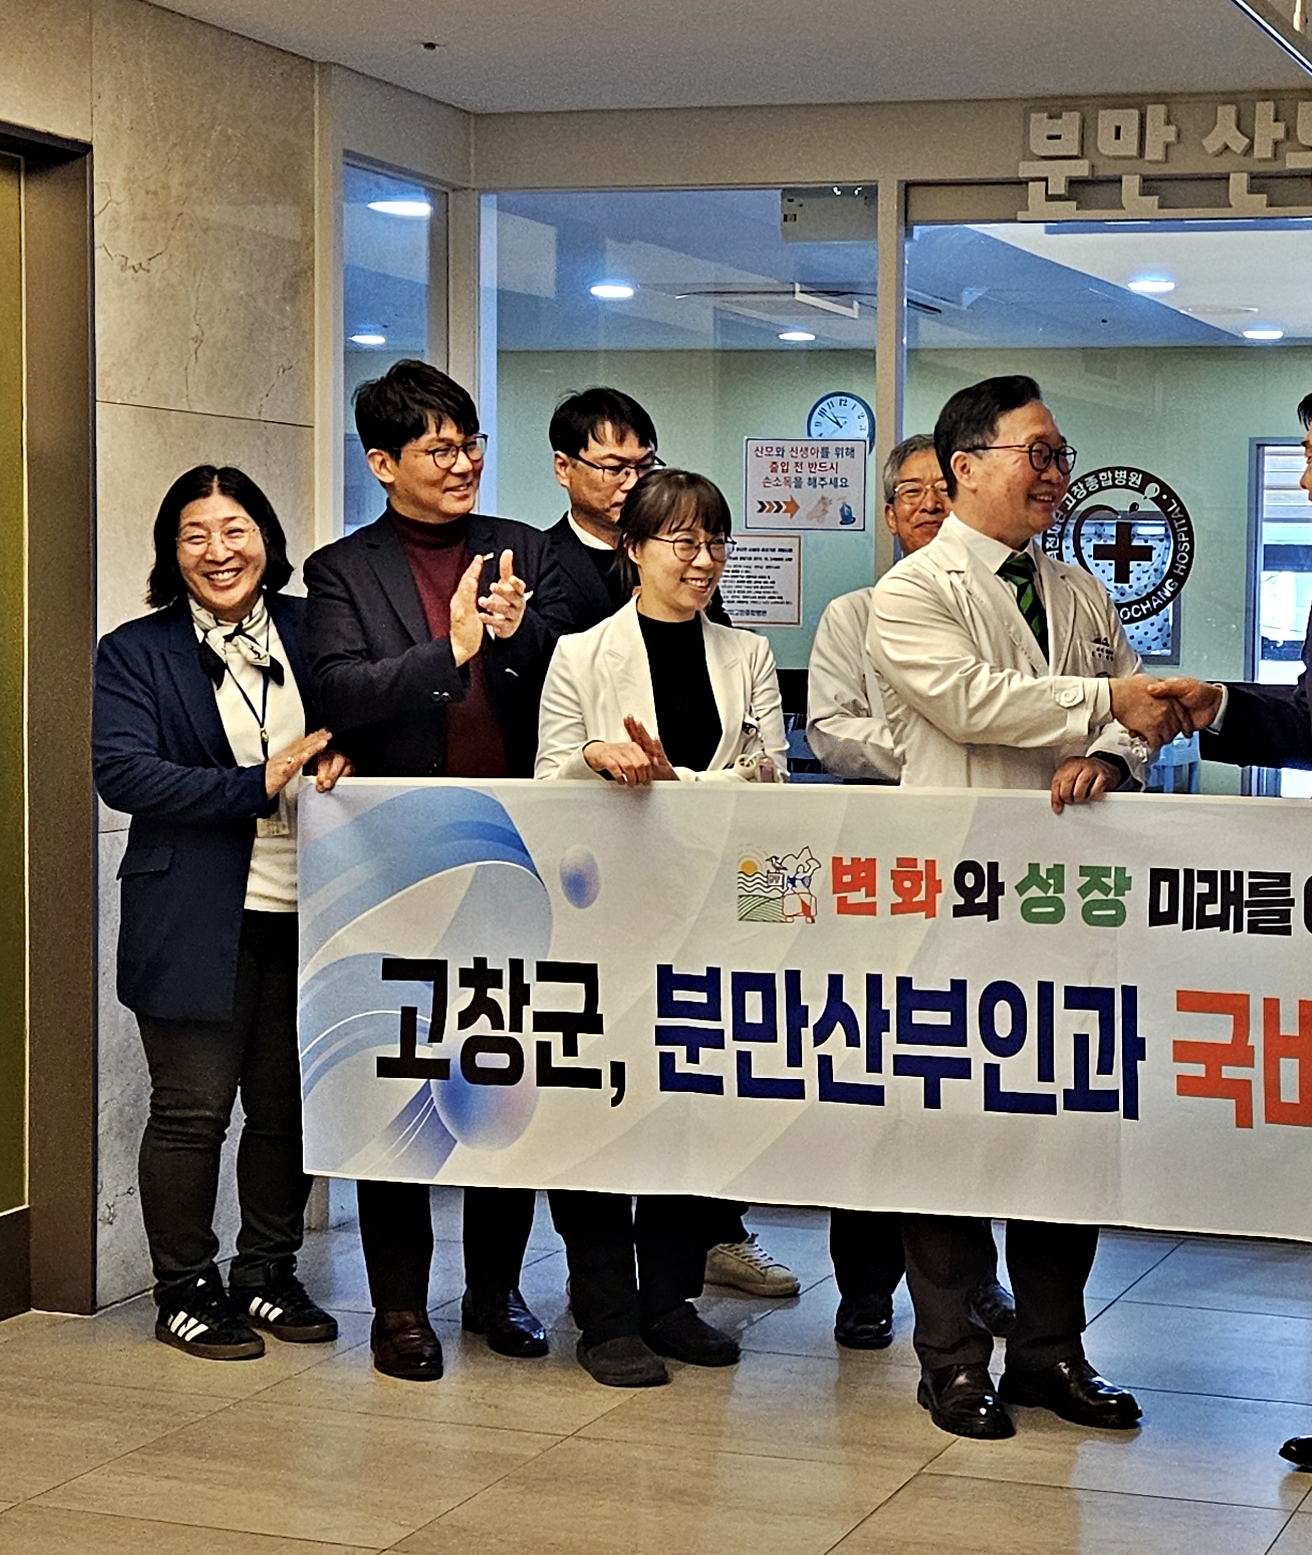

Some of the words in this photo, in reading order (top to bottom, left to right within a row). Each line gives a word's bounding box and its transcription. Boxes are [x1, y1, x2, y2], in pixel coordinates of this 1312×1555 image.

[1019, 104, 1176, 213] 분만
[754, 446, 786, 459] 산모와
[789, 446, 830, 459] 신생아를
[834, 446, 856, 459] 위해
[769, 461, 789, 474] 출입
[794, 461, 804, 474] 전
[808, 461, 839, 474] 반드시
[807, 476, 850, 489] 해주세요
[1166, 499, 1190, 576] HOSPITAL
[832, 856, 1005, 923] 변화와
[1017, 864, 1132, 927] 성장
[1149, 867, 1296, 935] 미래를
[377, 957, 626, 1108] 고창군,
[655, 964, 1146, 1120] 분만산부인과
